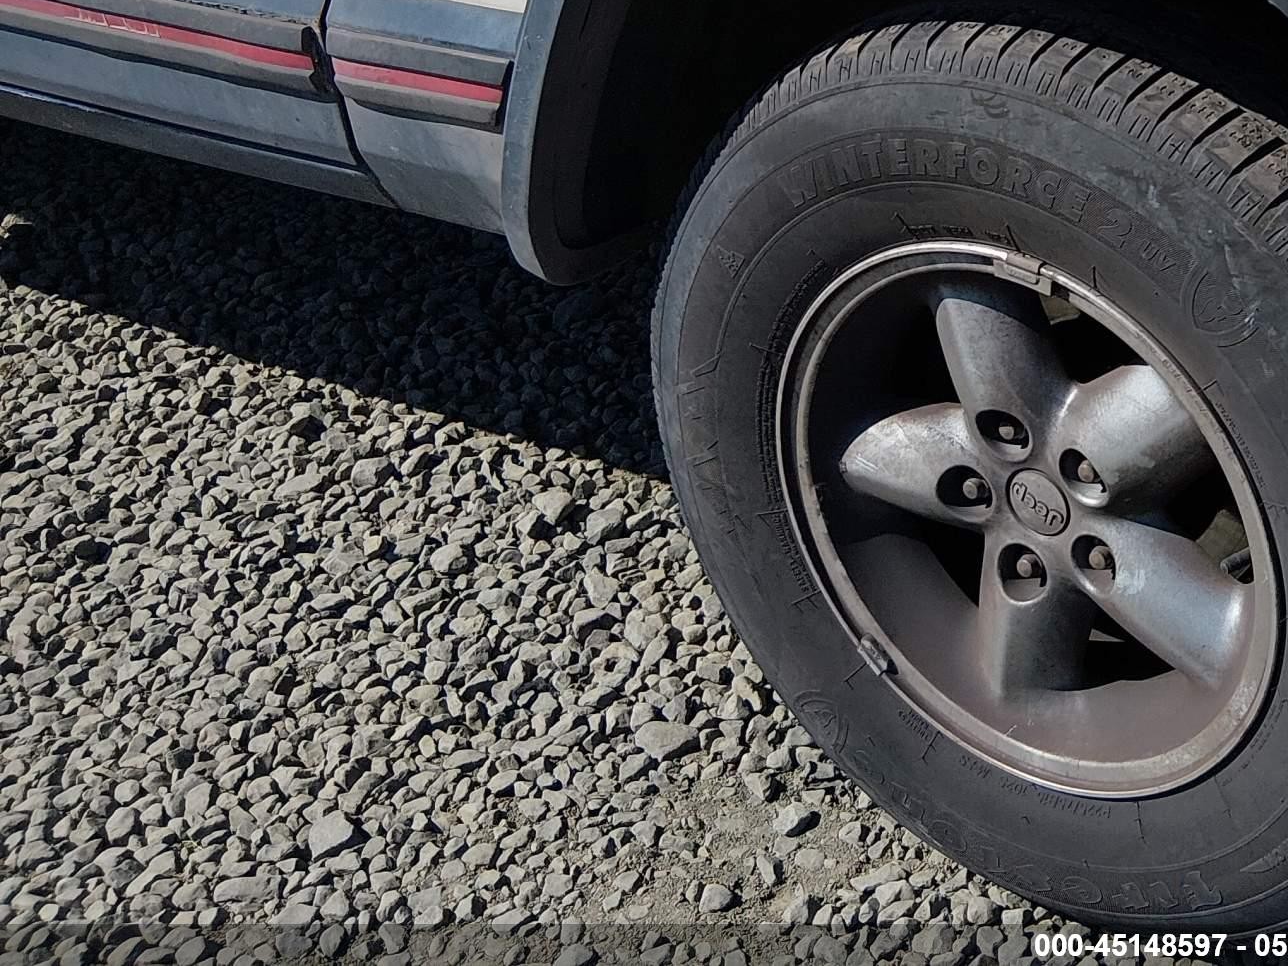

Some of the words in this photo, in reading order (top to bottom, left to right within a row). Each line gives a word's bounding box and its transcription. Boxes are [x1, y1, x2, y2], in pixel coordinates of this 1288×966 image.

[782, 137, 1094, 224] WINTERFORCE
[1098, 208, 1133, 250] 2
[1011, 481, 1065, 528] Jeep
